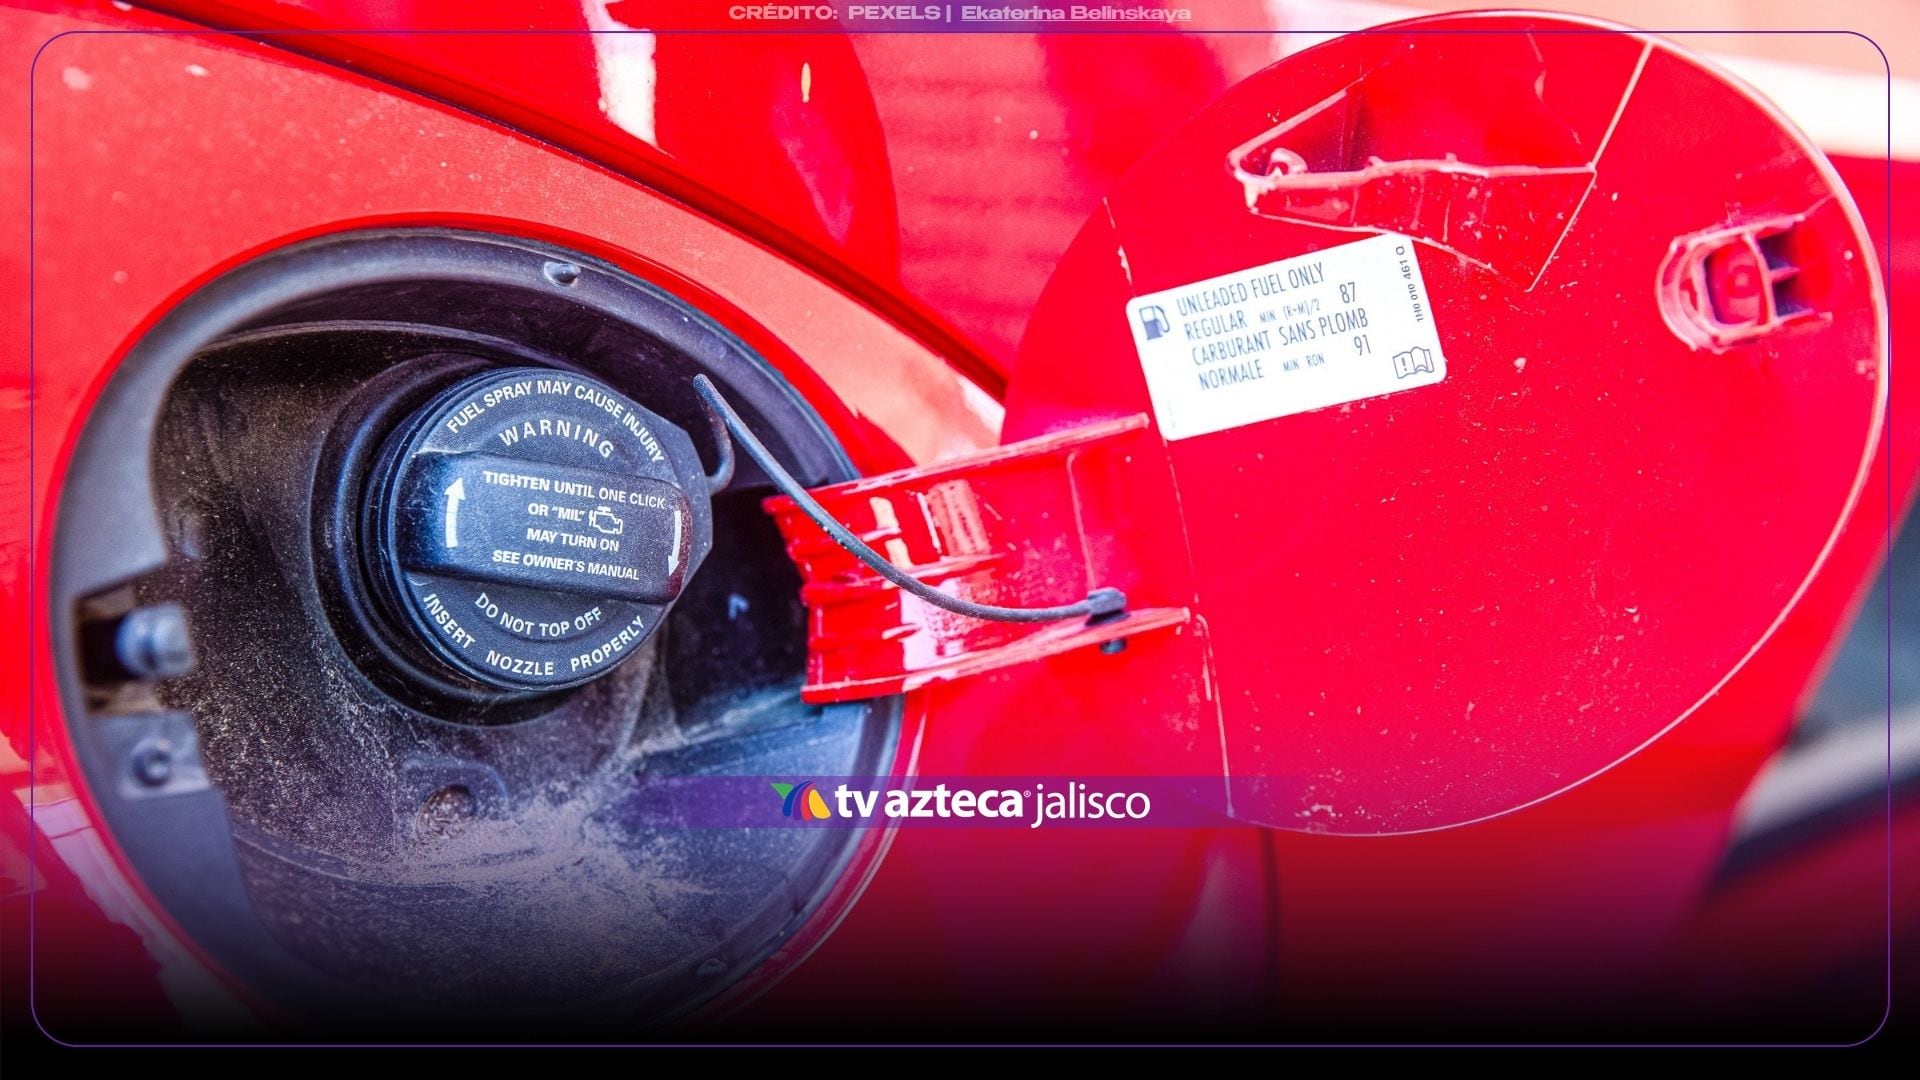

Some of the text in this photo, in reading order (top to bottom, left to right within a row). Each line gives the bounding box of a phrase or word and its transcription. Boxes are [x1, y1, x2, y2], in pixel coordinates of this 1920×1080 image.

[1176, 262, 1325, 316] UNLEADED FUEL ONLY
[1400, 259, 1413, 281] 461
[1184, 310, 1248, 341] REGULAR
[1259, 310, 1277, 323] MIN
[1339, 282, 1357, 304] 87
[1192, 307, 1369, 367] CARBURANT SANS PLOMB
[1199, 334, 1372, 390] NORMALE MIN RON 91
[446, 380, 665, 464] FUEL SPRAY MAY CAUSE INJURY
[498, 418, 614, 459] WARNING
[483, 470, 666, 510] TIGHTEN UNTIL ONE CLICK
[528, 502, 549, 517] OR
[526, 527, 620, 552] MAY TURN ON
[492, 549, 640, 581] SEE OWNER'S MANUAL
[423, 593, 645, 676] INSERT NOZZLE PROPERLY
[474, 592, 603, 637] DO NOT TOP OFF
